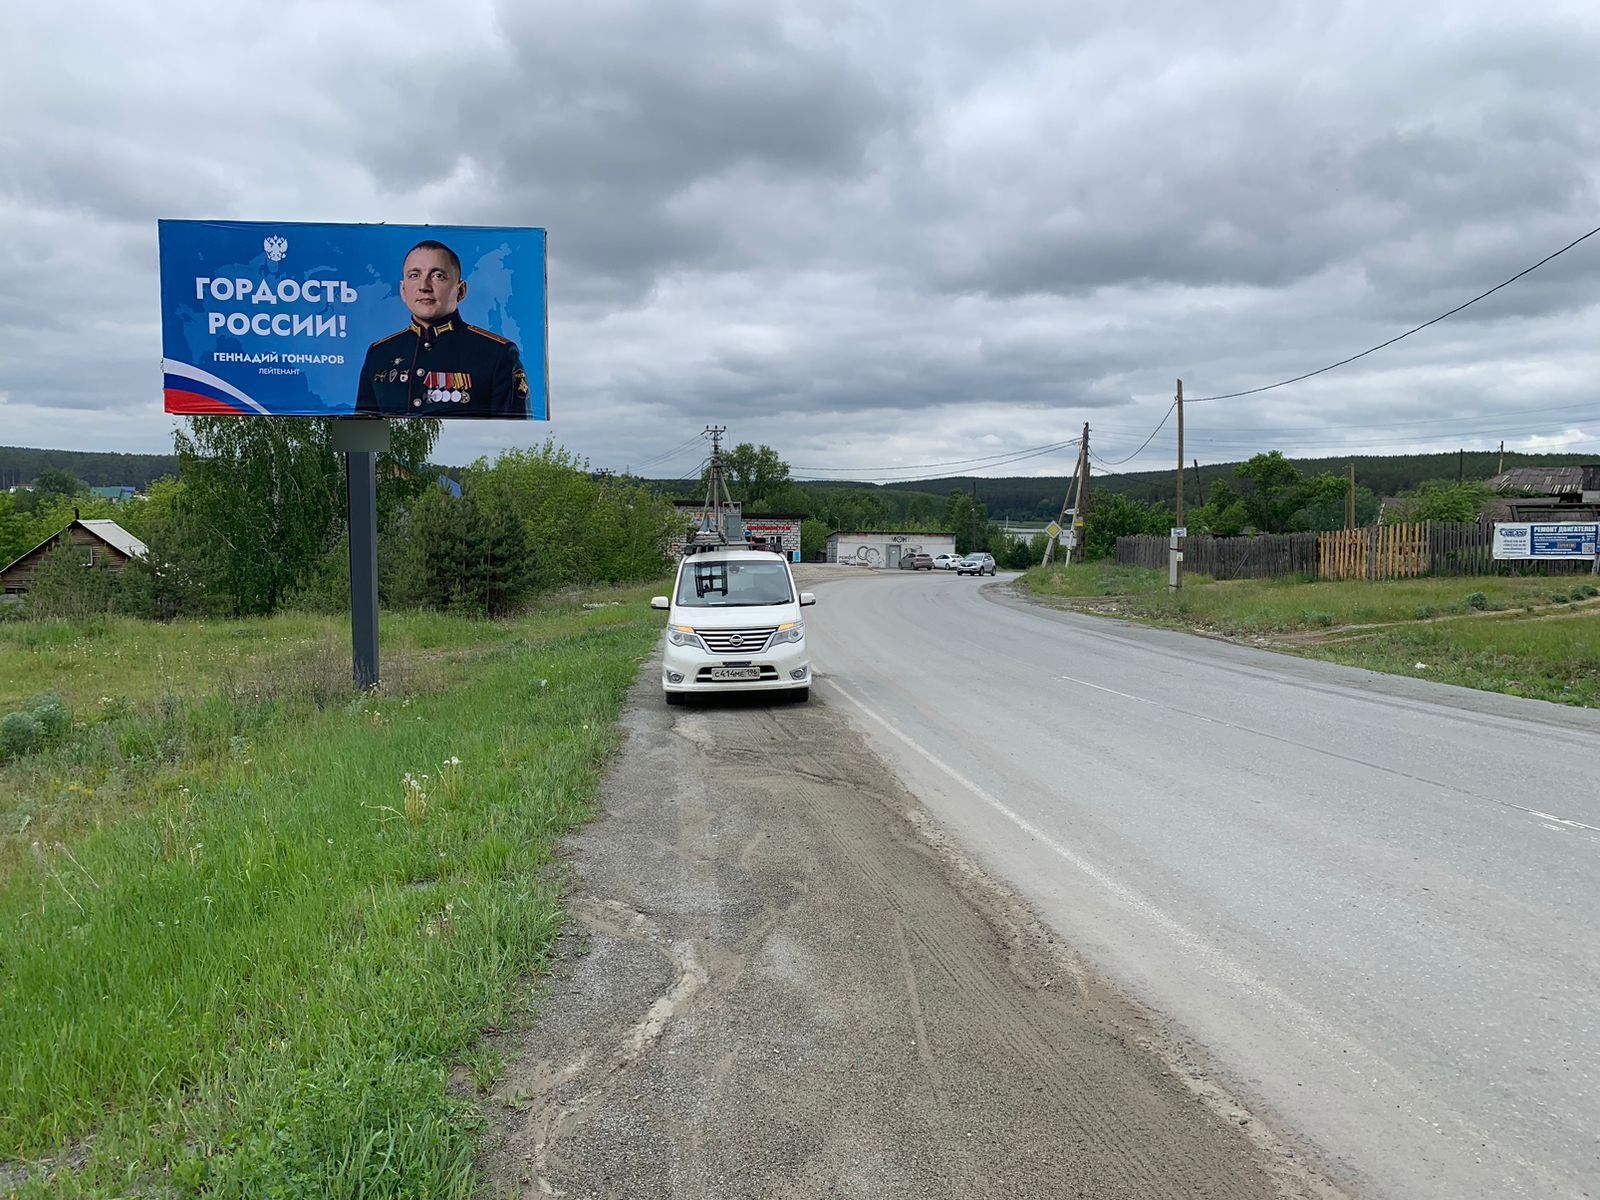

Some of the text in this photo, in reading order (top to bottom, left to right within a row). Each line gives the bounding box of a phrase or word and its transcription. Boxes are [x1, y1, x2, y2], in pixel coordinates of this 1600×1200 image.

[196, 277, 358, 304] ГОРДОСТЬ
[208, 313, 347, 338] РОССИИ!
[213, 351, 345, 364] ГЕННАДИЙ ГОНЧАРОВ
